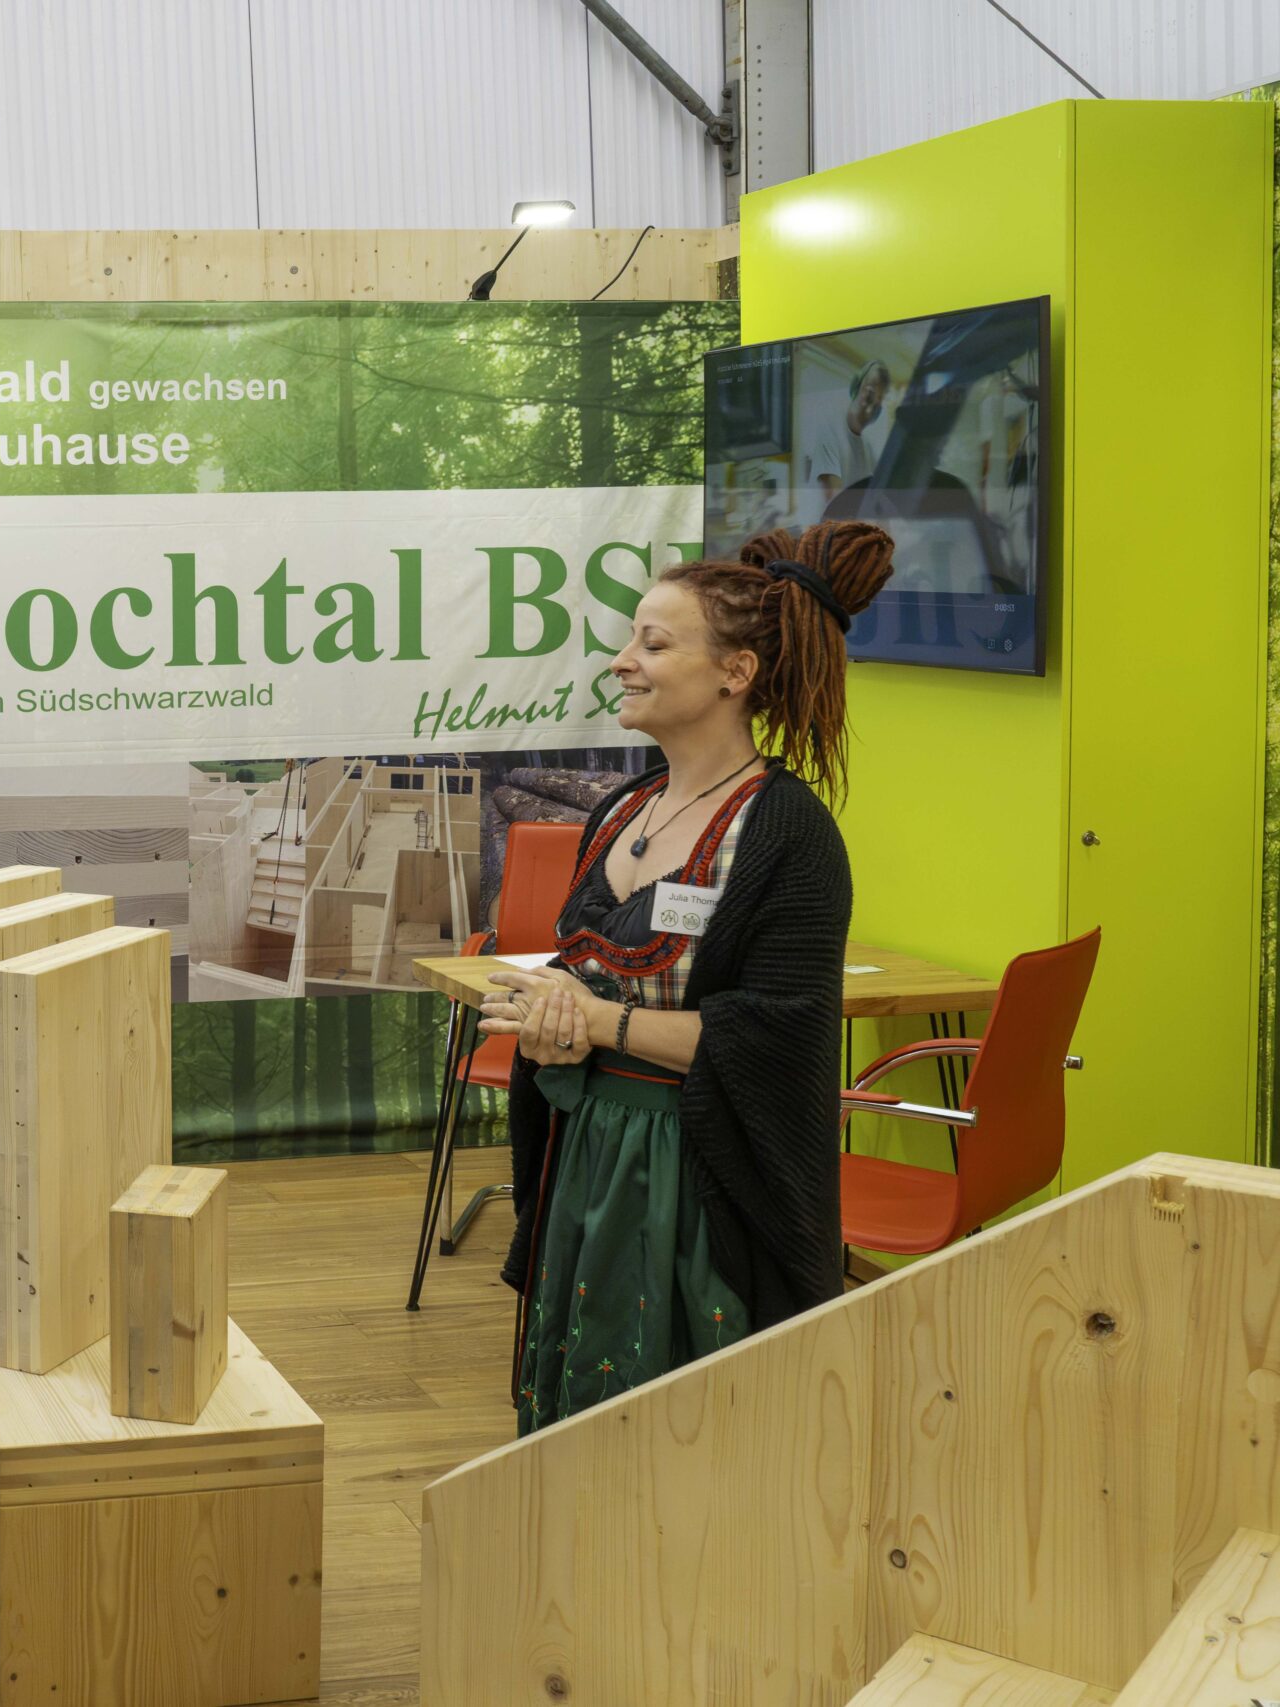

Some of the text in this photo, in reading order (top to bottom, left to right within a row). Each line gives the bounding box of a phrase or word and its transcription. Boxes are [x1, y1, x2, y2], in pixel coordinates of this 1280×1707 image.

[89, 373, 288, 409] gewachsen
[475, 541, 704, 659] BS
[17, 684, 274, 713] Südschwarzwald
[413, 682, 574, 741] Helmut
[668, 893, 718, 906] Julia Thom
